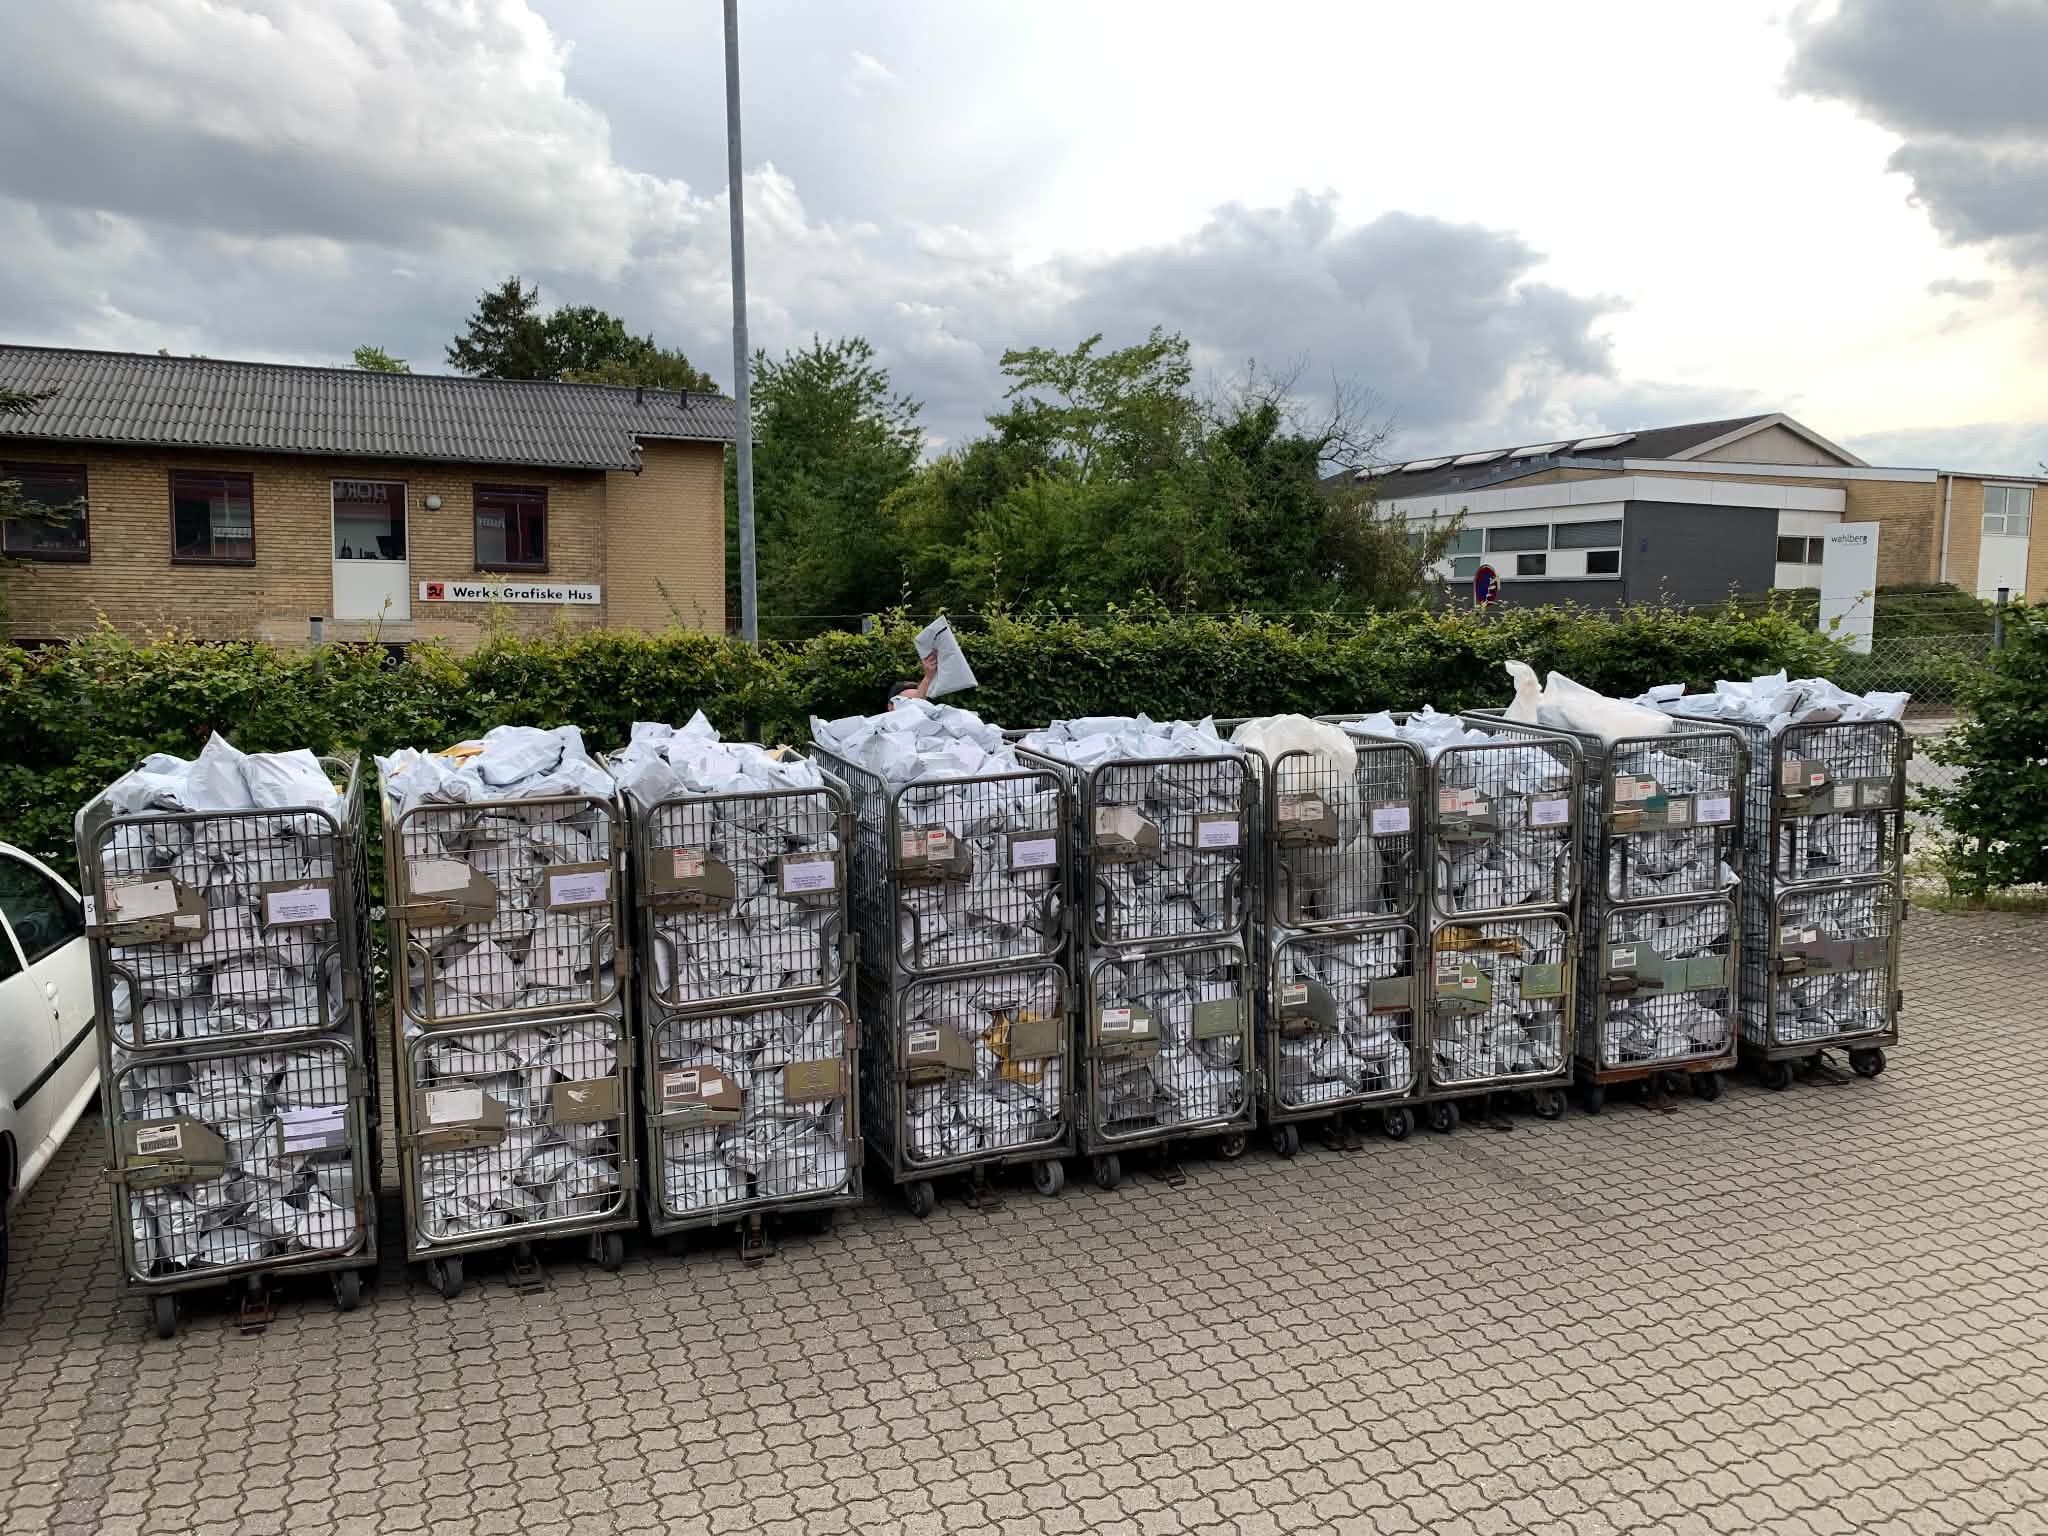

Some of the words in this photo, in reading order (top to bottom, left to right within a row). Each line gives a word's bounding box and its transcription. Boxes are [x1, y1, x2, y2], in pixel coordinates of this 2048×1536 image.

[1831, 534, 1868, 545] wahlberg
[503, 587, 563, 600] Grafiske
[568, 589, 593, 600] Hus
